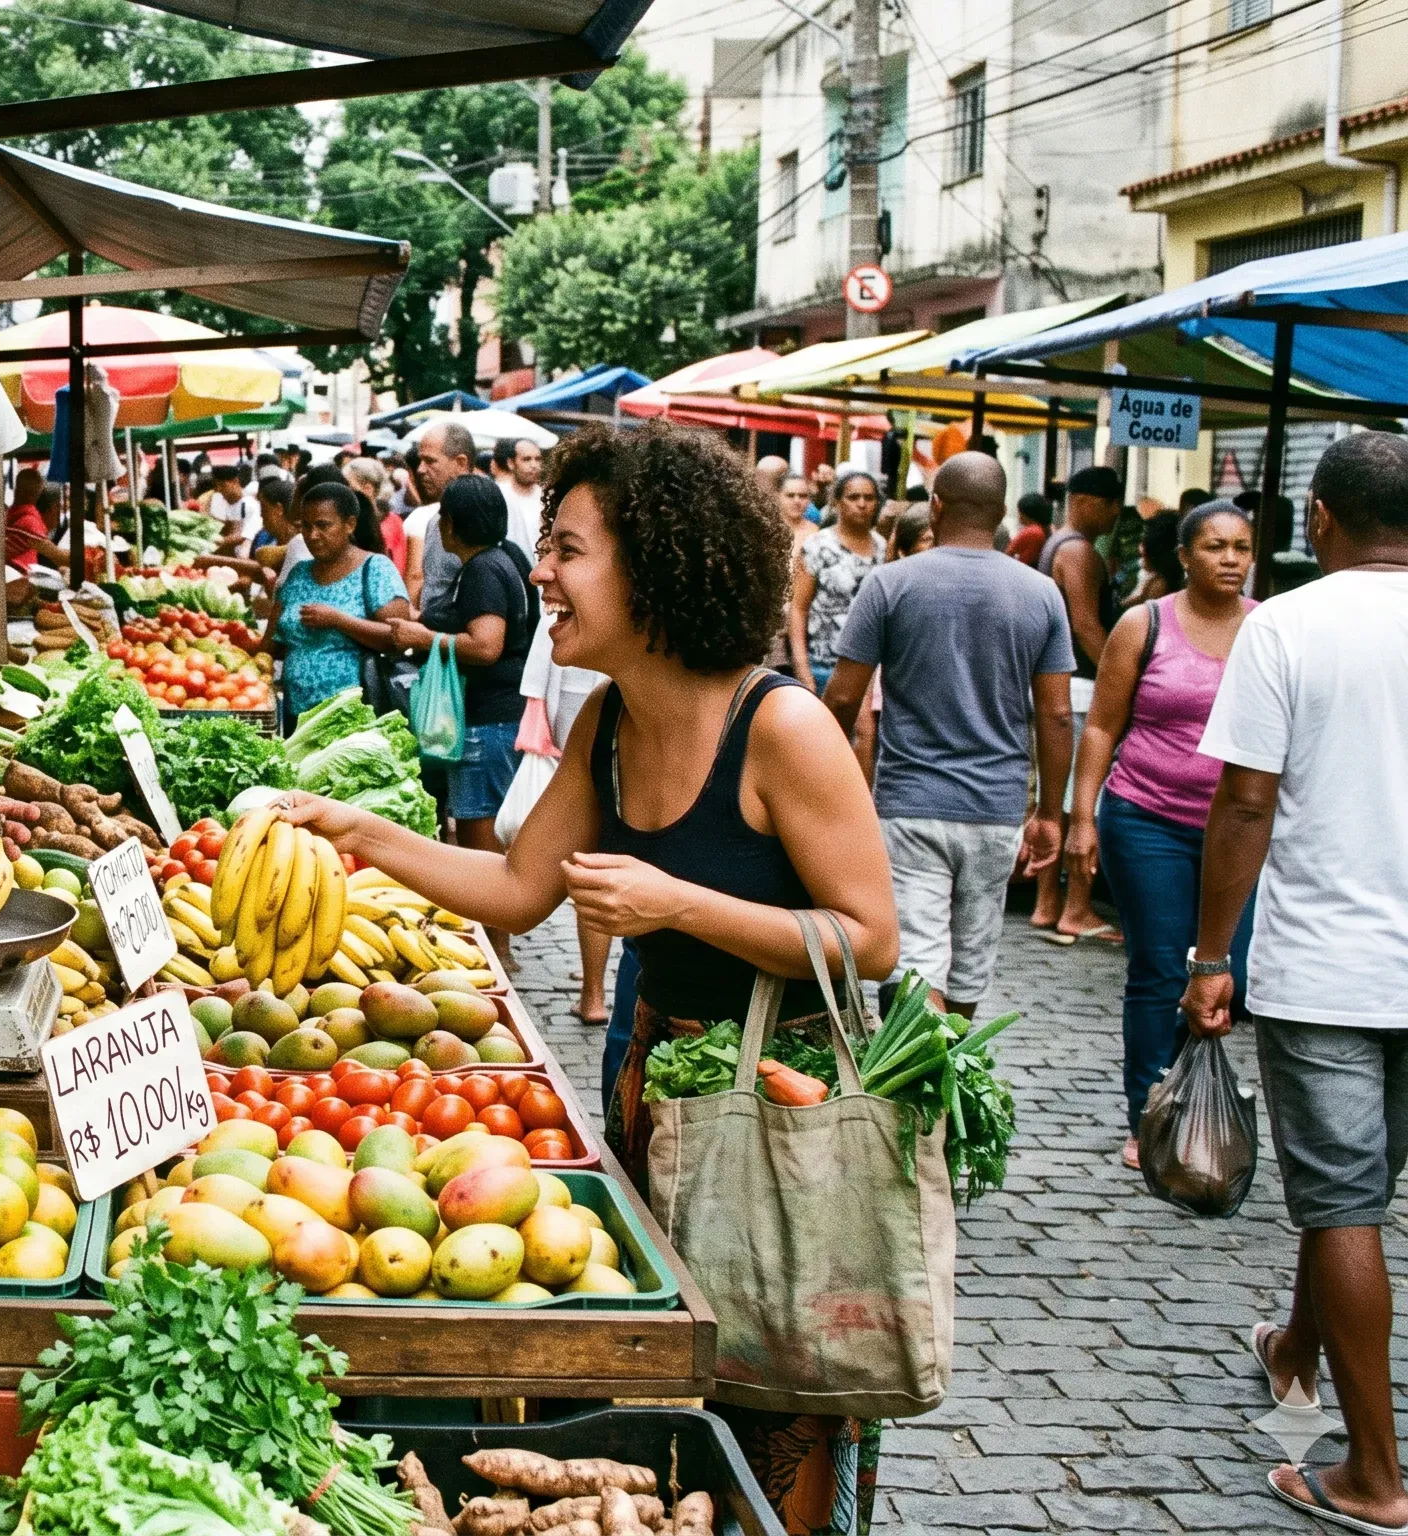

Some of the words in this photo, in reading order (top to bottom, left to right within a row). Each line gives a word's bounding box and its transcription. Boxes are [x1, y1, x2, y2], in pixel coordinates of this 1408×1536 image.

[1129, 421, 1182, 443] Coco!
[1170, 398, 1193, 418] de
[51, 1008, 181, 1097] LARANJA
[69, 1121, 101, 1169] R$
[107, 1065, 210, 1160] 10,00/kg
